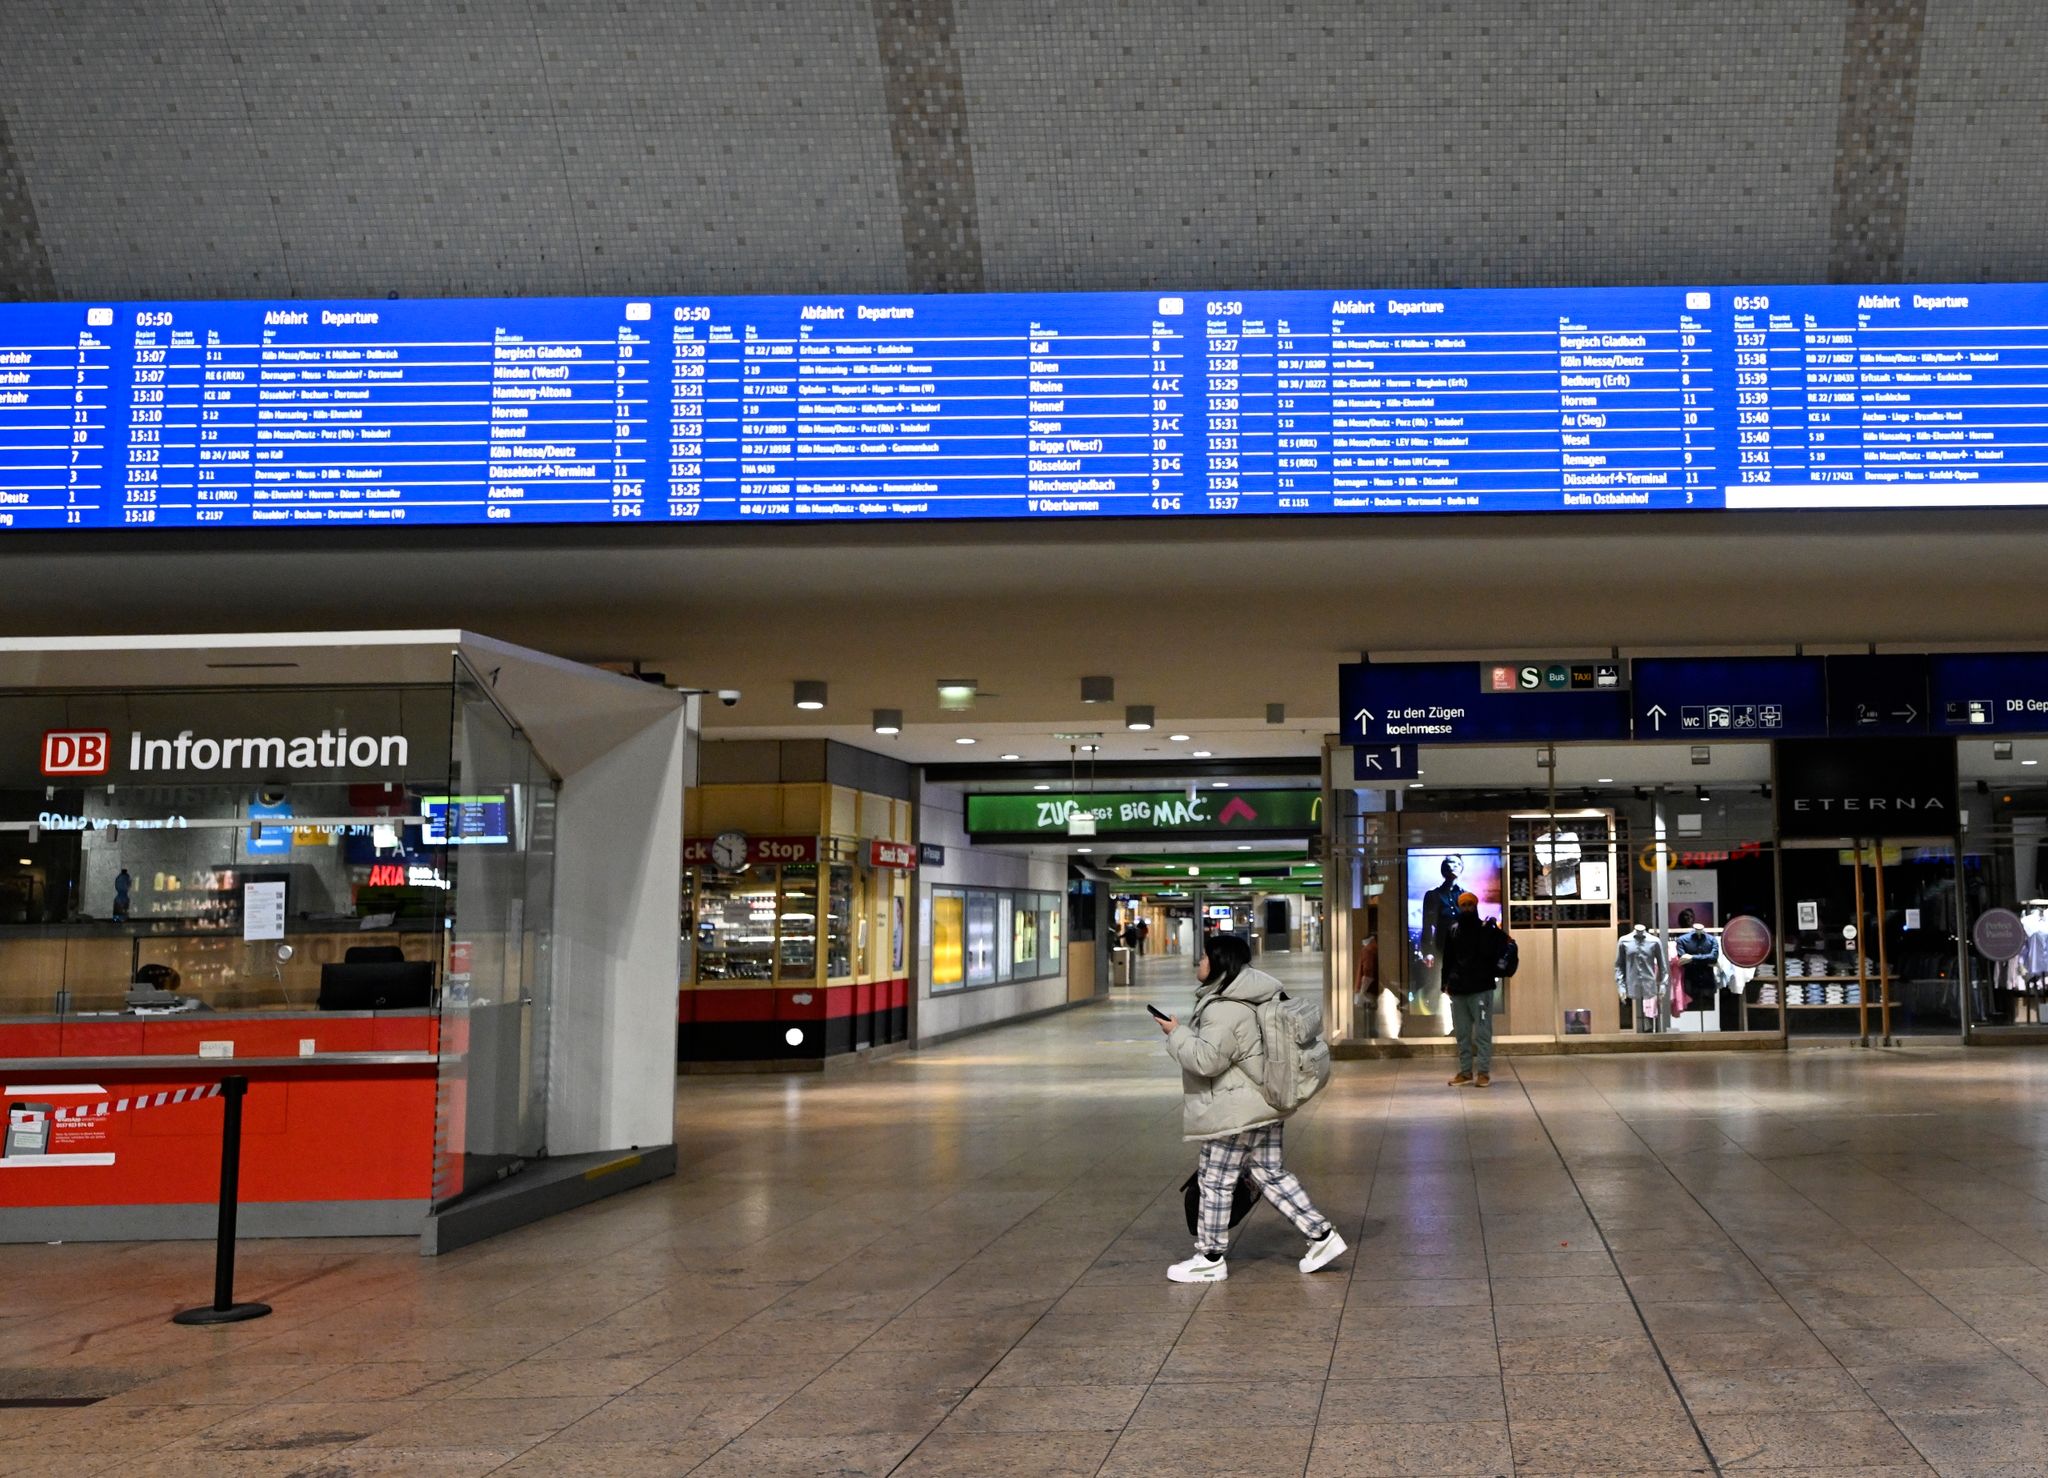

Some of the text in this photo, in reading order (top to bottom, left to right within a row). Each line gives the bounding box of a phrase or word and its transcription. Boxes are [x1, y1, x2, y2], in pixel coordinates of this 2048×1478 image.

[1207, 302, 1242, 315] 05:50
[1332, 300, 1444, 315] Abfahrt Departure
[1734, 296, 1769, 310] 05:50
[1858, 295, 1968, 310] Abfahrt Departure
[137, 312, 172, 326] 05:50
[265, 311, 378, 326] Abfahrt Departure
[674, 307, 710, 321] 05:50
[801, 306, 914, 321] Abfahrt Departure
[1209, 340, 1238, 351] 15:27
[1560, 335, 1646, 349] Bergisch Gladbach
[1682, 335, 1695, 346] 10
[1737, 334, 1765, 345] 15:37
[494, 346, 582, 360] Bergisch Gladbach
[619, 346, 632, 357] 10
[676, 345, 705, 357] 15:20
[1030, 342, 1049, 353] Kall
[79, 351, 85, 363] 1
[137, 351, 165, 362] 15:07
[1561, 355, 1644, 368] Köln Messe/Deutz
[1738, 354, 1766, 365] 15:38
[675, 365, 704, 377] 15:20
[1030, 361, 1058, 373] Düren
[1209, 359, 1238, 371] 15:28
[77, 371, 84, 383] 5
[135, 370, 164, 382] 15:07
[494, 366, 569, 379] Minden (Westf)
[617, 367, 625, 377] 9
[1209, 379, 1238, 390] 15:29
[1561, 374, 1630, 388] Bedburg (Erft)
[1739, 373, 1767, 384] 15:39
[618, 385, 624, 397] 5
[674, 385, 702, 396] 15:21
[1030, 381, 1063, 392] Rheine
[76, 391, 83, 402] 6
[134, 390, 163, 402] 15:10
[493, 387, 572, 400] Hamburg-Altona
[1684, 394, 1696, 404] 11
[1739, 393, 1768, 404] 15:39
[1030, 400, 1064, 412] Hennef
[1210, 399, 1238, 410] 15:30
[1562, 395, 1597, 406] Horrem
[133, 410, 162, 422] 15:10
[492, 407, 528, 418] Horrem
[617, 405, 629, 416] 11
[674, 404, 702, 416] 15:21
[75, 411, 87, 422] 11
[1562, 414, 1606, 428] Au (Sieg)
[1685, 413, 1697, 424] 10
[1740, 412, 1769, 423] 15:40
[673, 424, 702, 436] 15:23
[1029, 420, 1061, 434] Siegen
[1210, 418, 1237, 430] 15:31
[74, 431, 87, 442] 10
[131, 430, 159, 442] 15:11
[491, 426, 526, 438] Hennef
[617, 425, 629, 436] 10
[1209, 438, 1237, 449] 15:31
[1562, 434, 1590, 445] Wesel
[1741, 432, 1769, 443] 15:40
[491, 445, 576, 459] Köln Messe/Deutz
[615, 445, 621, 456] 1
[672, 444, 701, 456] 15:24
[1029, 439, 1102, 455] Brügge (Westf)
[72, 451, 78, 463] 7
[130, 450, 159, 462] 15:12
[1563, 454, 1606, 467] Remagen
[1741, 451, 1769, 463] 15:41
[1029, 460, 1080, 471] Düsseldorf
[1209, 458, 1238, 469] 15:34
[128, 470, 157, 482] 15:14
[490, 464, 595, 478] Düsseldorf Terminal
[615, 465, 627, 476] 11
[672, 464, 701, 476] 15:24
[70, 471, 77, 483] 3
[1210, 477, 1238, 489] 15:34
[1564, 472, 1667, 485] Düsseldorf Terminal
[1686, 472, 1698, 483] 11
[1742, 471, 1770, 483] 15:42
[488, 486, 524, 498] Aachen
[613, 484, 641, 496] 9 D-G
[671, 484, 700, 496] 15:25
[1029, 479, 1115, 493] Mönchengladbach
[69, 491, 75, 503] 1
[127, 490, 156, 502] 15:15
[1564, 493, 1648, 504] Berlin Ostbahnhof
[1040, 500, 1099, 511] Oberbarmen
[1210, 497, 1238, 509] 15:37
[126, 510, 155, 522] 15:18
[487, 506, 511, 518] Gera
[613, 504, 641, 516] 5 D-G
[671, 504, 699, 516] 15:27
[68, 511, 80, 522] 11
[1521, 667, 1591, 688] S Bus TAXI
[2006, 699, 2024, 711] DB
[1387, 706, 1465, 720] zu den Zügen
[1684, 717, 1700, 726] WC
[1709, 714, 1718, 727] P
[1386, 723, 1452, 735] koelnmesse
[49, 729, 408, 770] DB Information
[1391, 745, 1401, 768] 1
[1794, 797, 1945, 811] ETERNA
[684, 841, 805, 861] ck Stop
